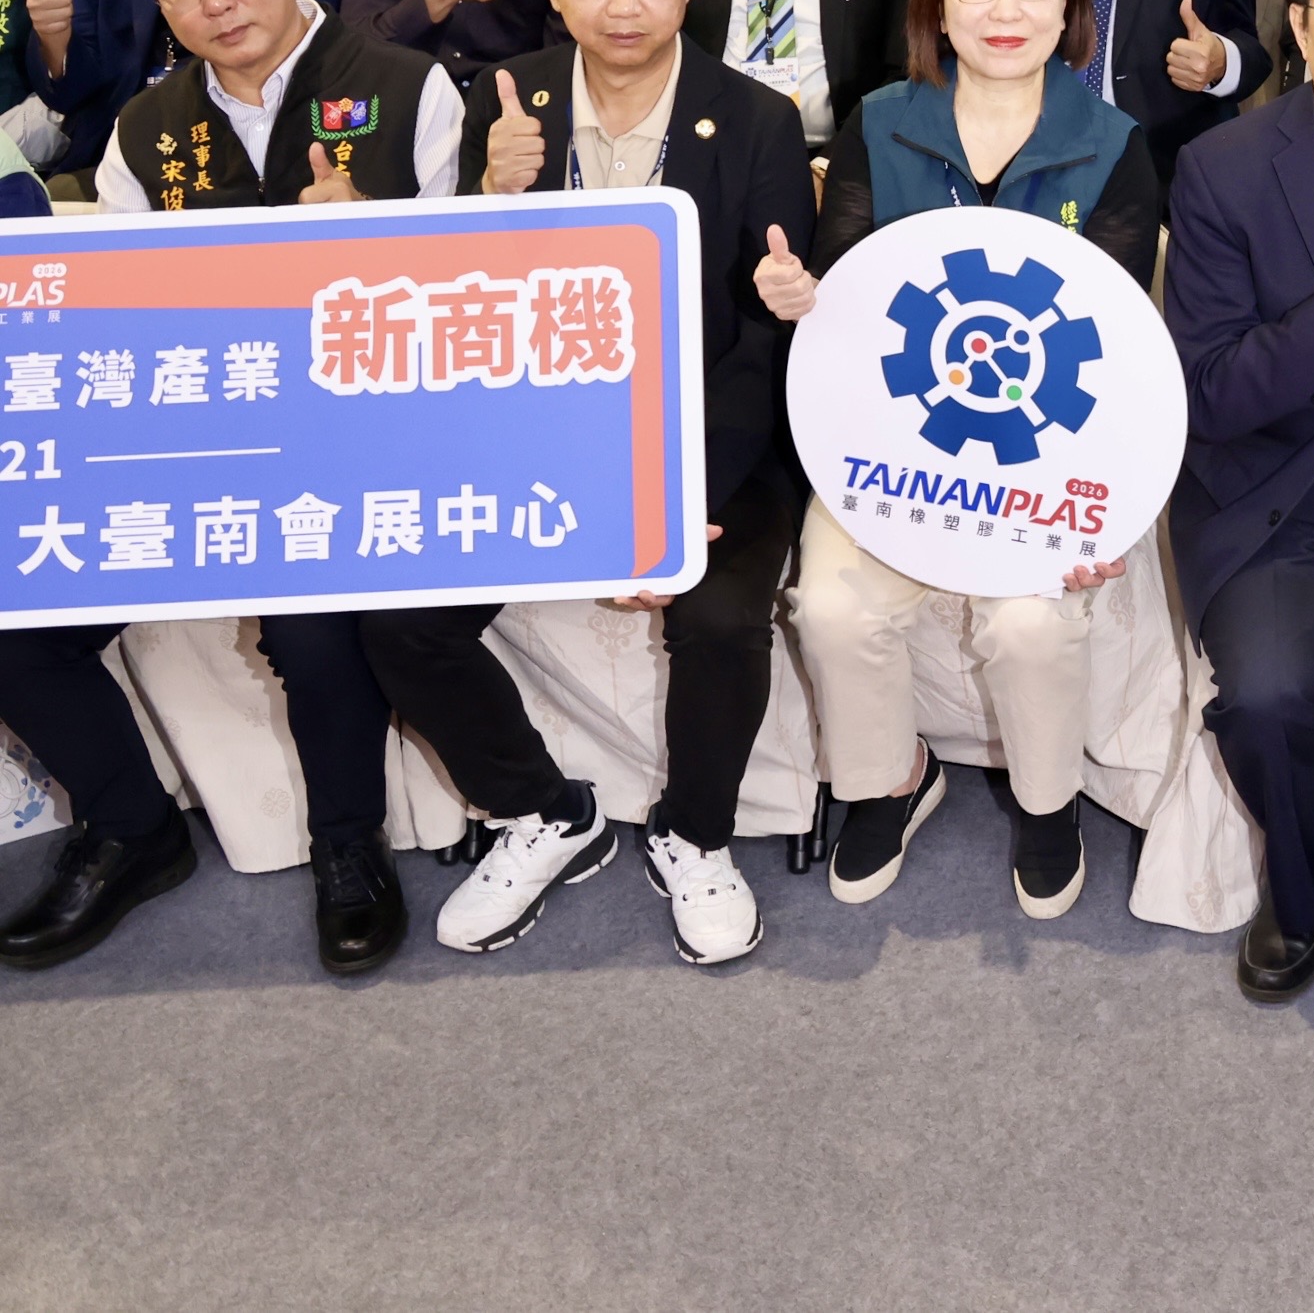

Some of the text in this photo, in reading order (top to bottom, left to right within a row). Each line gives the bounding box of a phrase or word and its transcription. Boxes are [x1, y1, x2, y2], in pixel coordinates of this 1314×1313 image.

[190, 120, 214, 192] 理事長
[1060, 200, 1079, 234] 經
[36, 264, 64, 276] 2026
[318, 274, 626, 386] 新商機
[3, 340, 281, 414] 臺灣產業
[0, 438, 62, 482] 21
[1071, 481, 1104, 498] 2026
[17, 480, 579, 575] 大臺南會展中心
[840, 493, 1098, 559] 臺南橡塑膠工業展
